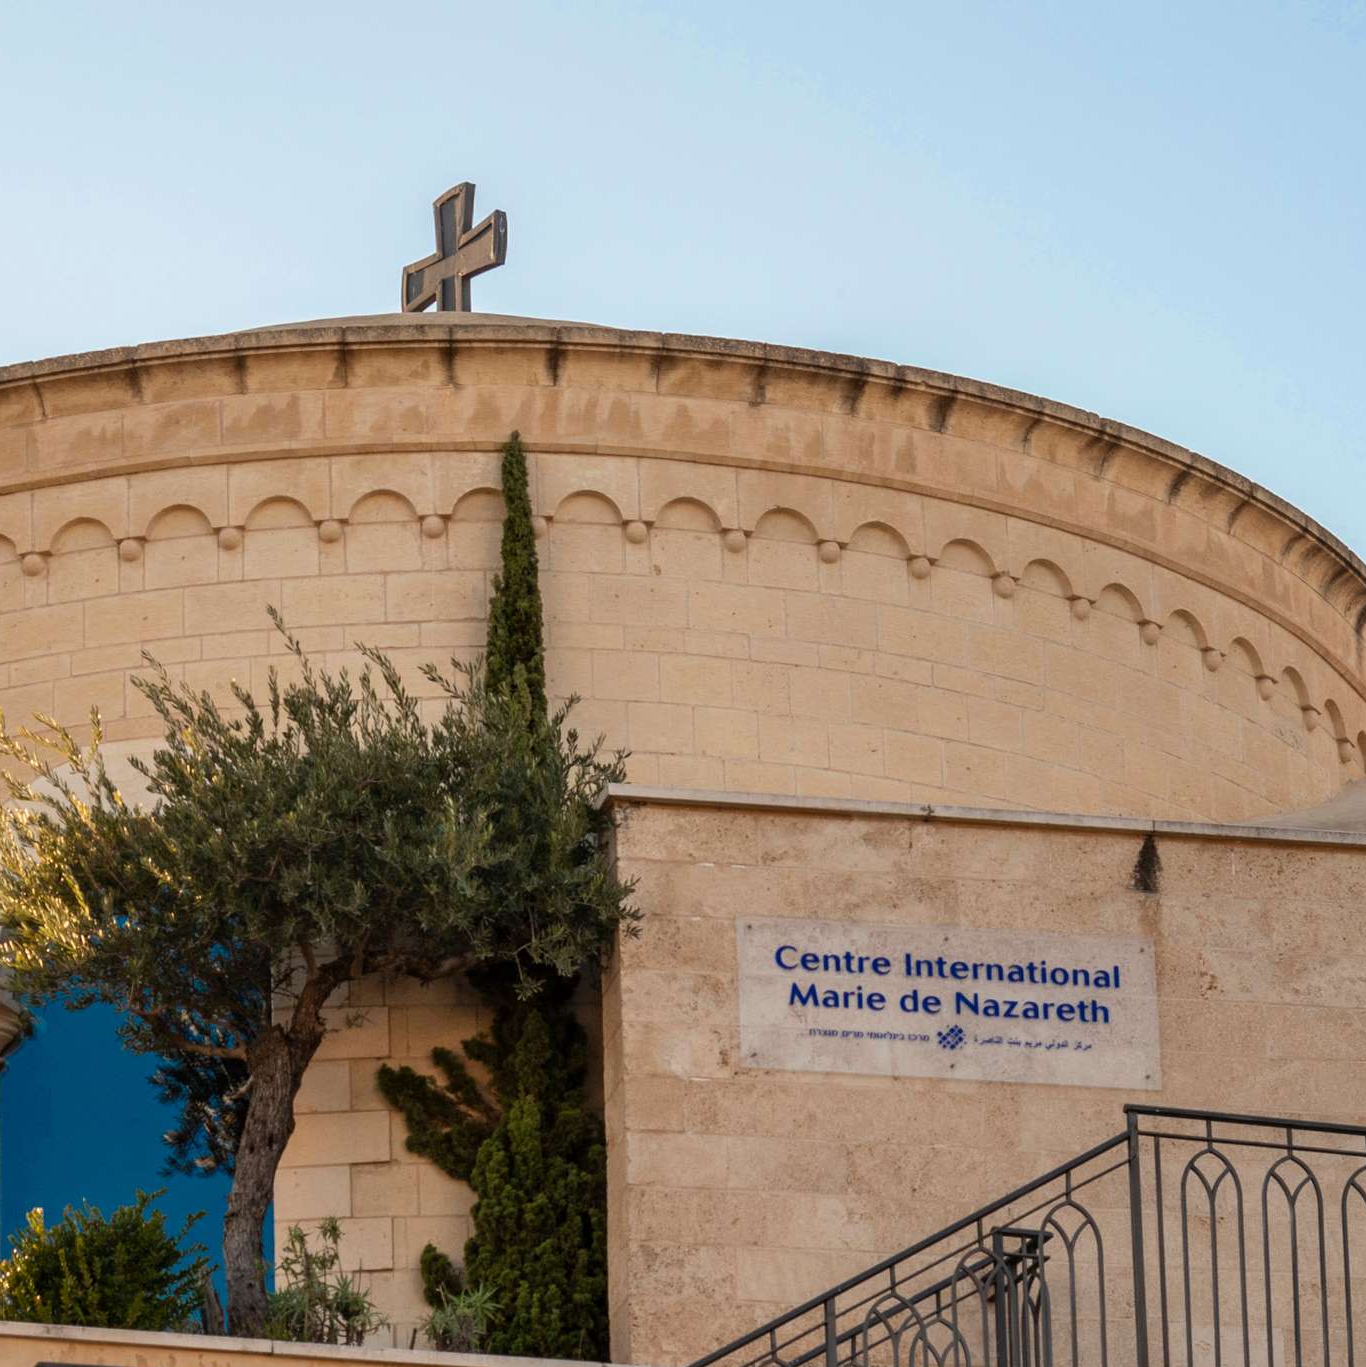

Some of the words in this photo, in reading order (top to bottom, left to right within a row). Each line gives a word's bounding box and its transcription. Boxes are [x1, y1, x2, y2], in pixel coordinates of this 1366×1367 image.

[773, 945, 891, 976] Centre
[904, 953, 1121, 990] International
[788, 982, 887, 1011] Marie
[898, 990, 941, 1014] de
[954, 991, 1111, 1025] Nazareth
